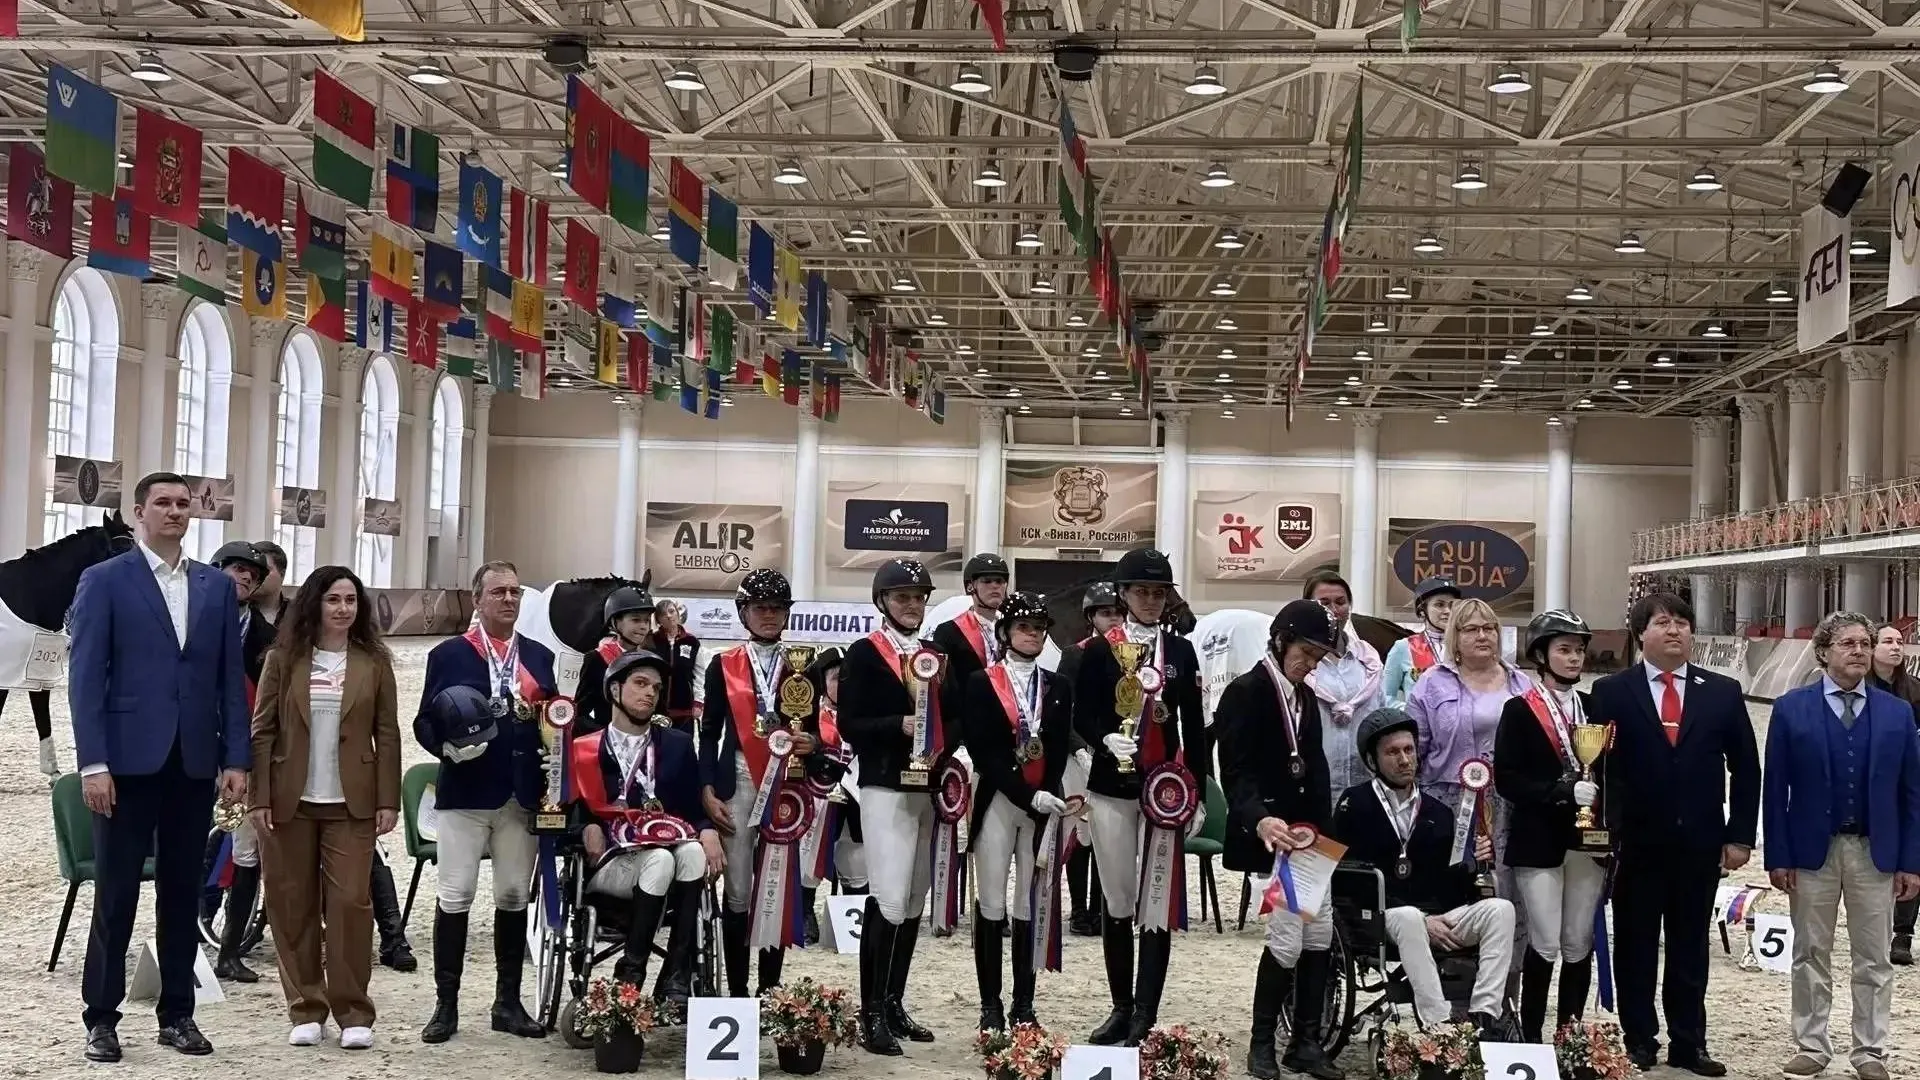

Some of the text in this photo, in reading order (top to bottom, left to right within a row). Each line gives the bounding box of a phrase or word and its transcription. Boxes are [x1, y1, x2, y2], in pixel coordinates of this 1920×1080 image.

[1804, 233, 1843, 302] FEI
[672, 521, 754, 551] ALIR
[862, 526, 930, 536] ЛАБОРАТОРИЯ
[1021, 527, 1041, 539] КСК
[1044, 528, 1085, 541] «Виват,
[1280, 520, 1310, 531] EML
[674, 552, 750, 573] EMBRYOS
[1413, 539, 1485, 564] EQUI
[1413, 563, 1506, 588] MEDIA
[787, 613, 874, 633] ПИОНАТ
[845, 908, 864, 939] 3
[1760, 927, 1787, 958] 5
[706, 1015, 740, 1061] 2
